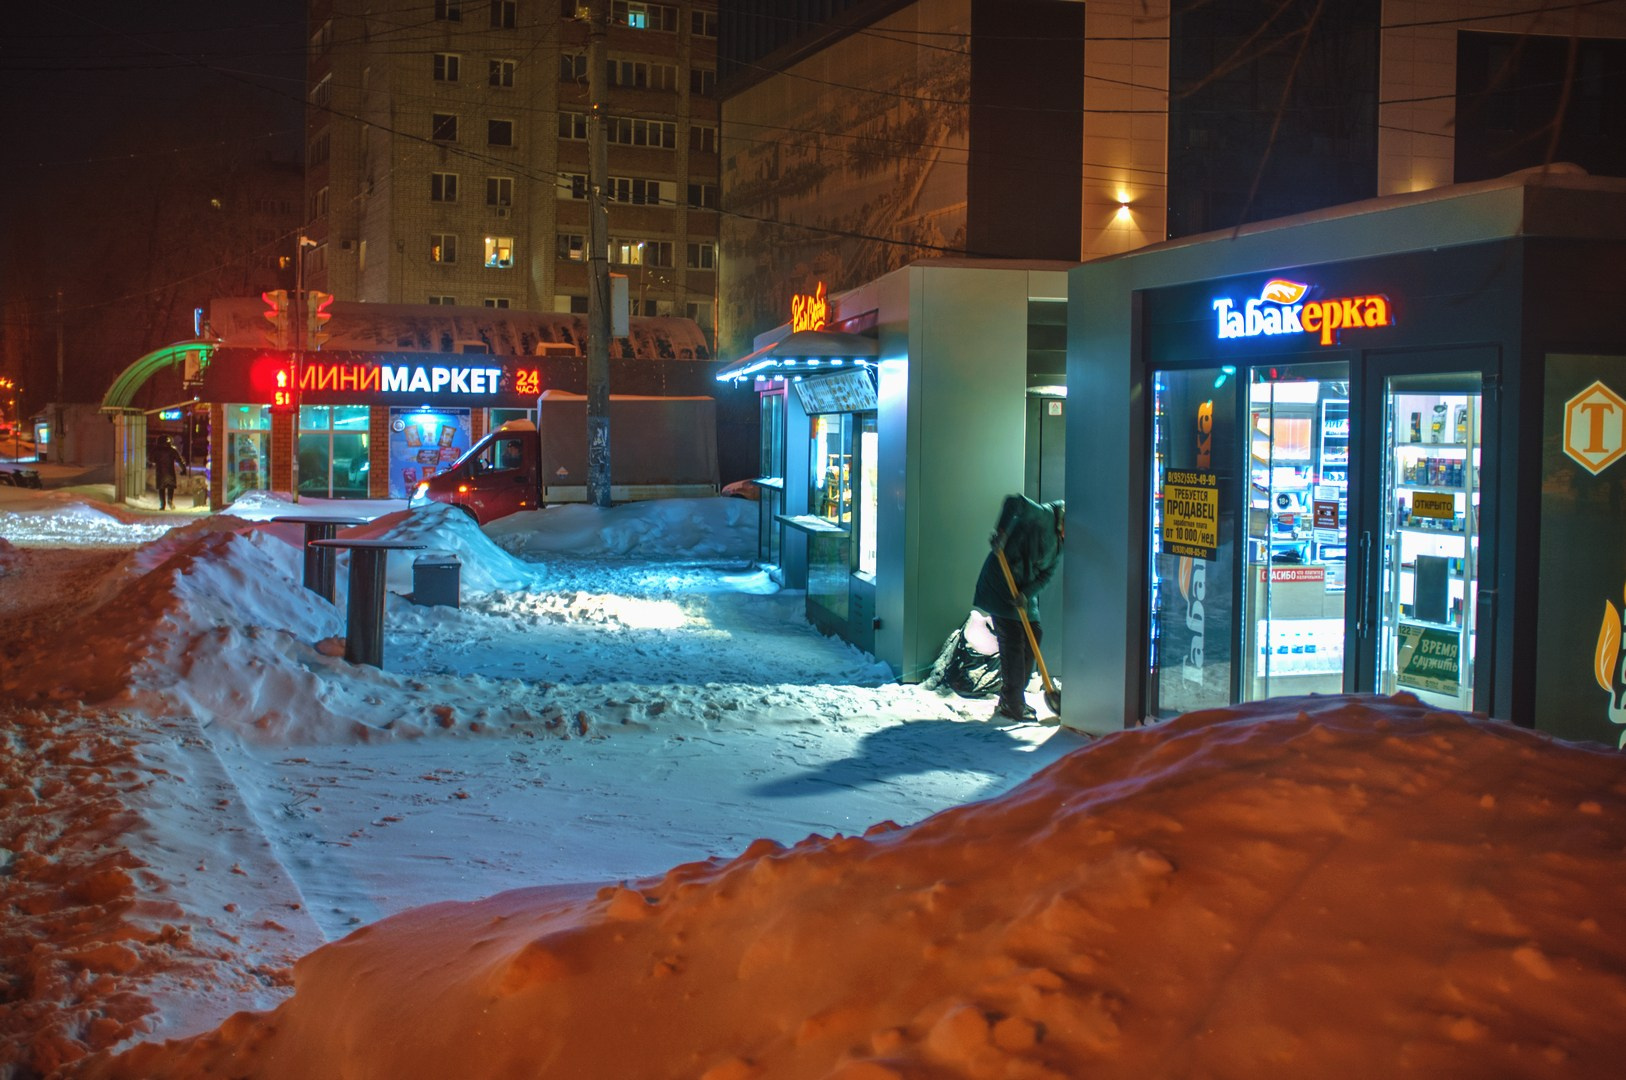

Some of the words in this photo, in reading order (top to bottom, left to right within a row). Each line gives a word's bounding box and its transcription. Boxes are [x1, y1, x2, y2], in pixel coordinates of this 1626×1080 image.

[1213, 294, 1387, 345] Табакерка
[516, 370, 539, 386] 24
[516, 385, 539, 395] ЧАСА
[1174, 488, 1208, 502] ТРЕБУЕТСЯ
[1166, 499, 1215, 522] ПРОДАВЕЦ
[1414, 499, 1453, 511] ОТКРЫТО
[1166, 528, 1173, 538] от
[1176, 527, 1183, 540] 10
[1261, 570, 1296, 580] САСИБО
[1399, 625, 1411, 635] 122
[1421, 639, 1458, 658] ВРЕМЯ
